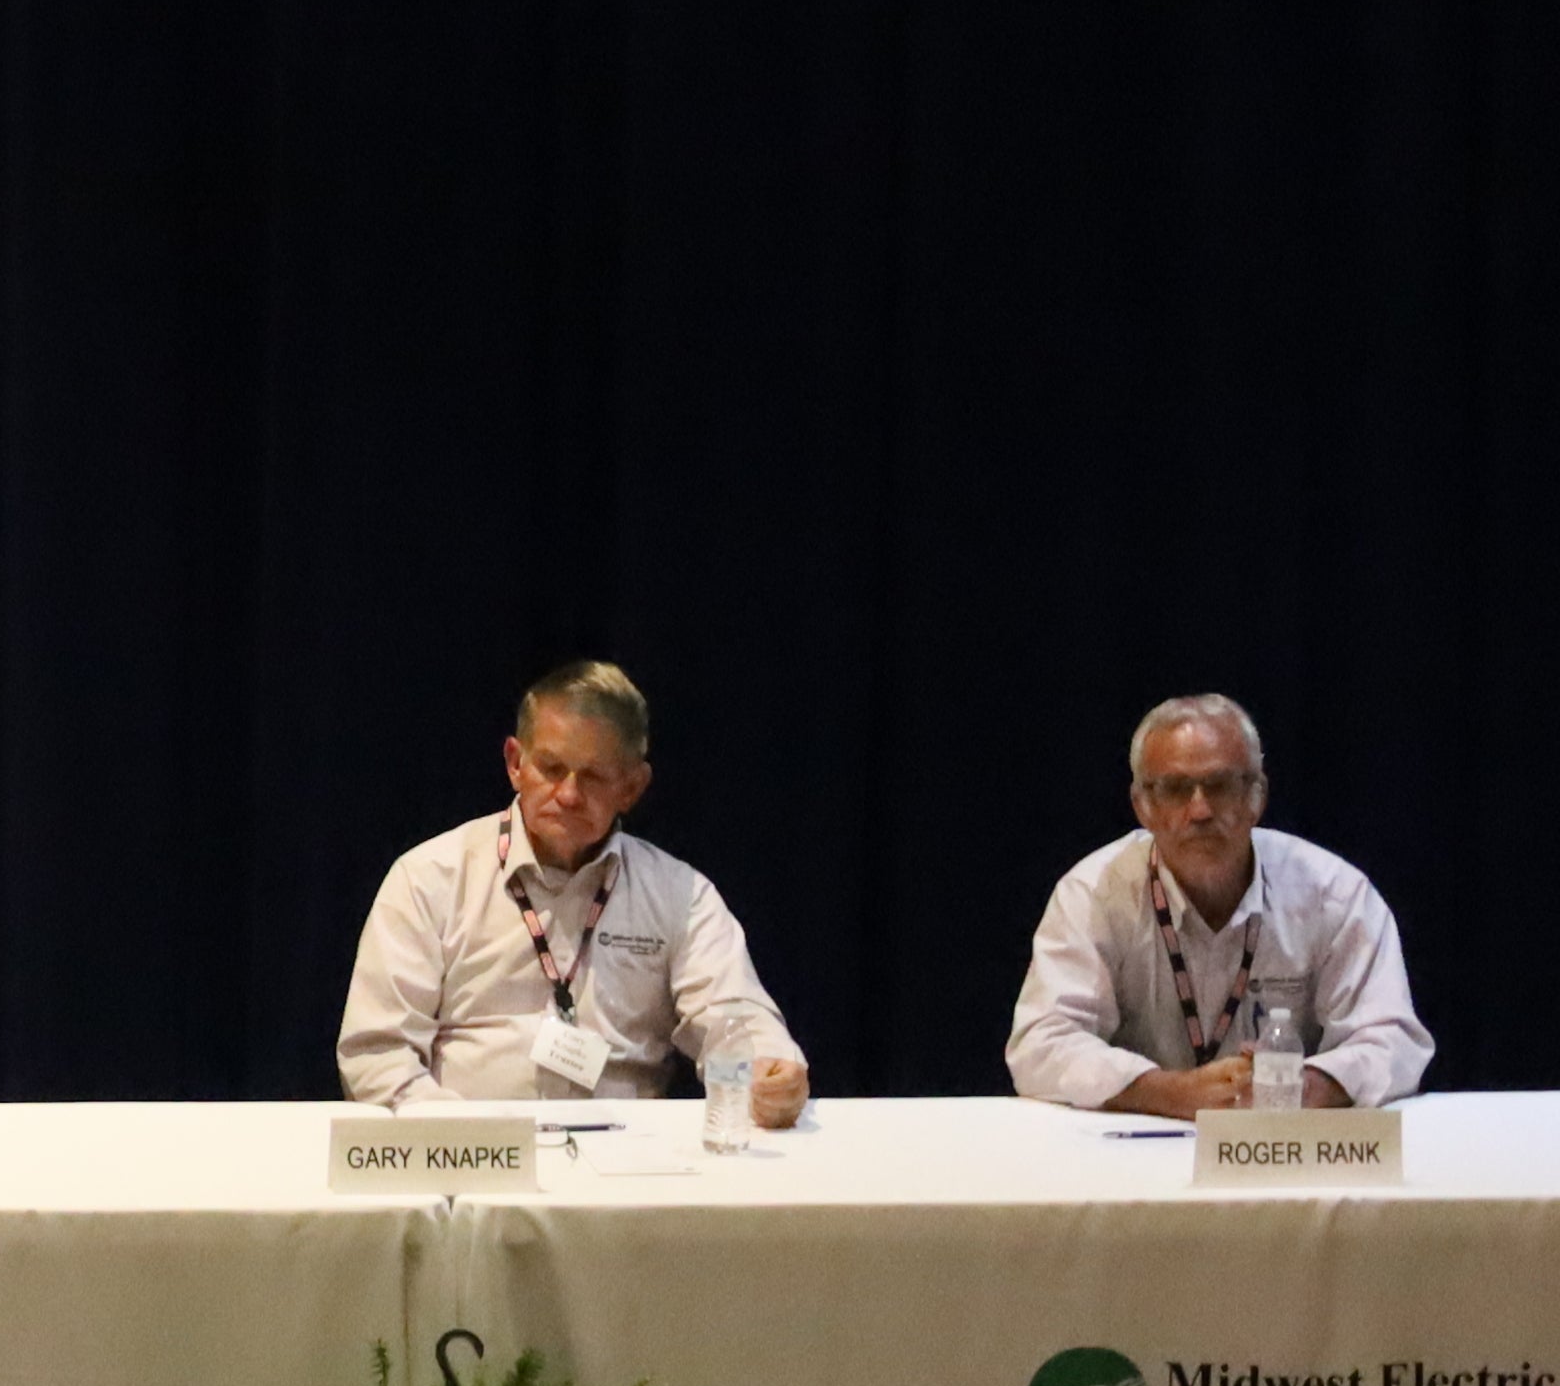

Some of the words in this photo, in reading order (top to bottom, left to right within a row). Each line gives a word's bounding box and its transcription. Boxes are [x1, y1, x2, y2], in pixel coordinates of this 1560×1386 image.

[346, 1146, 413, 1169] GARY
[426, 1146, 520, 1169] KNAPKE
[1218, 1141, 1303, 1165] ROGER
[1316, 1141, 1380, 1164] RANK
